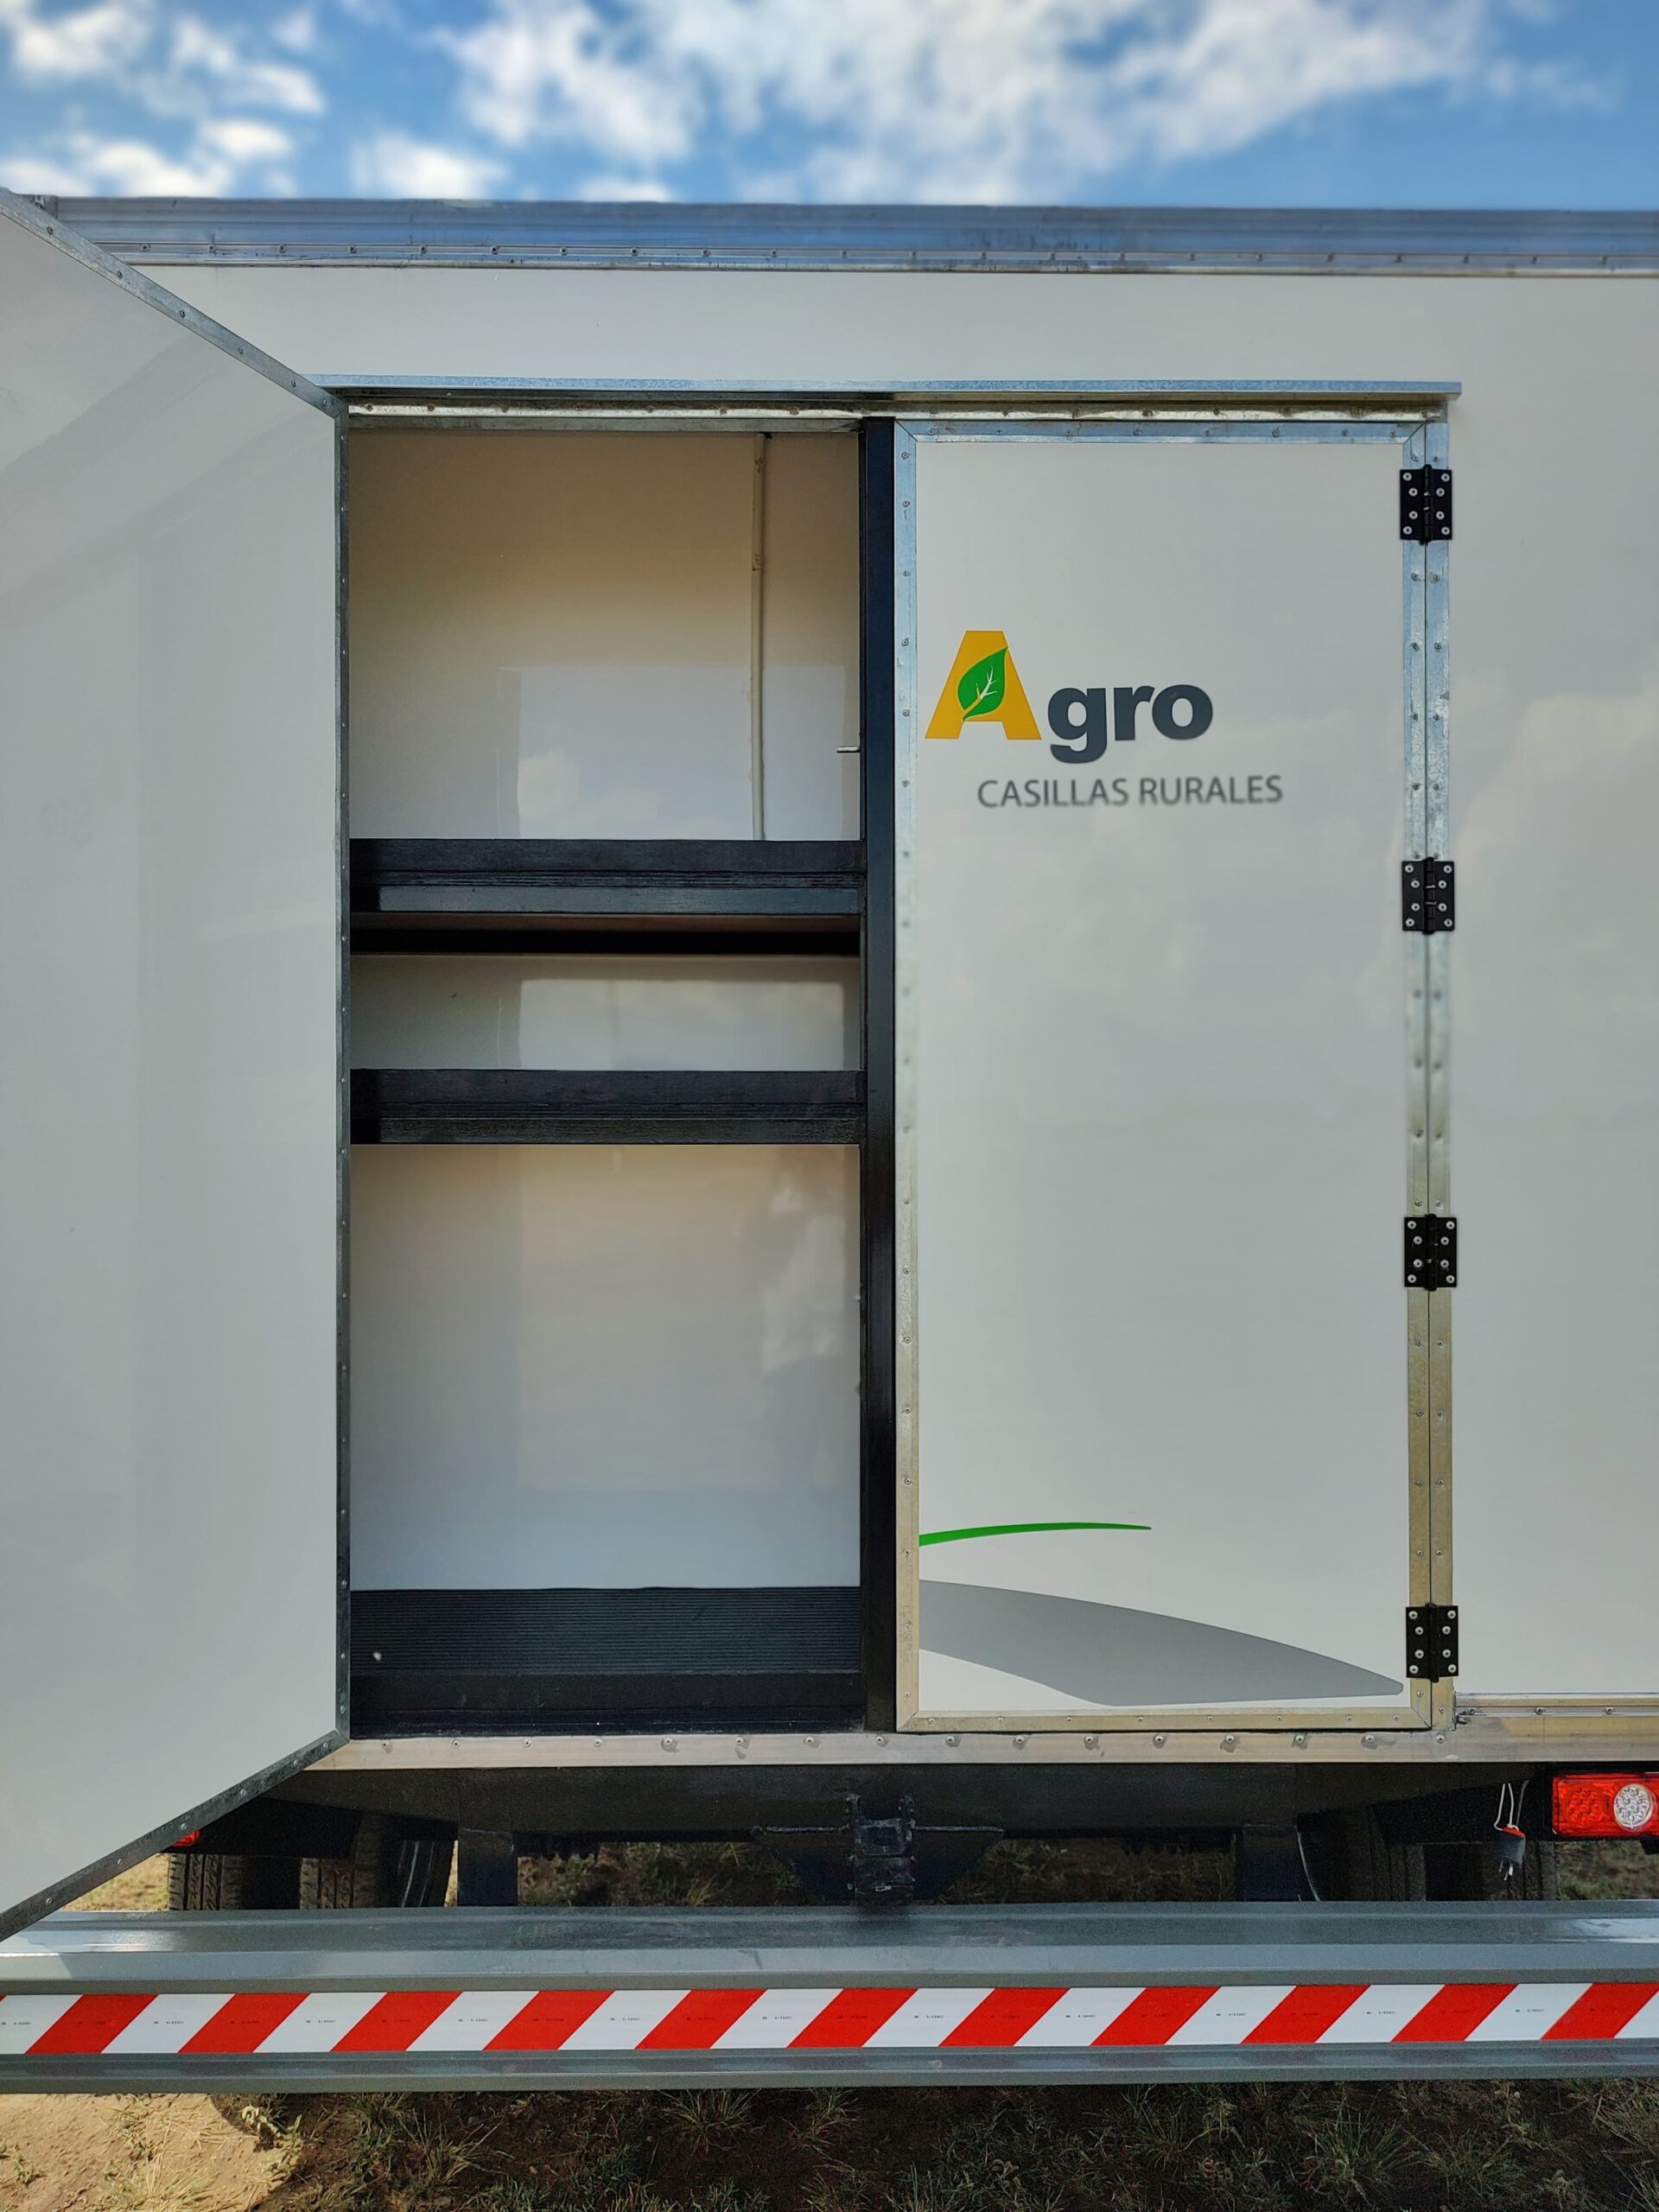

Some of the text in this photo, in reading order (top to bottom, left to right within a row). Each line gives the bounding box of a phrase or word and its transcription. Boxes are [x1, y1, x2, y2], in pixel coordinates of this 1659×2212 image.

[925, 630, 1213, 764] Agro
[977, 775, 1283, 808] CASILLAS RURALES
